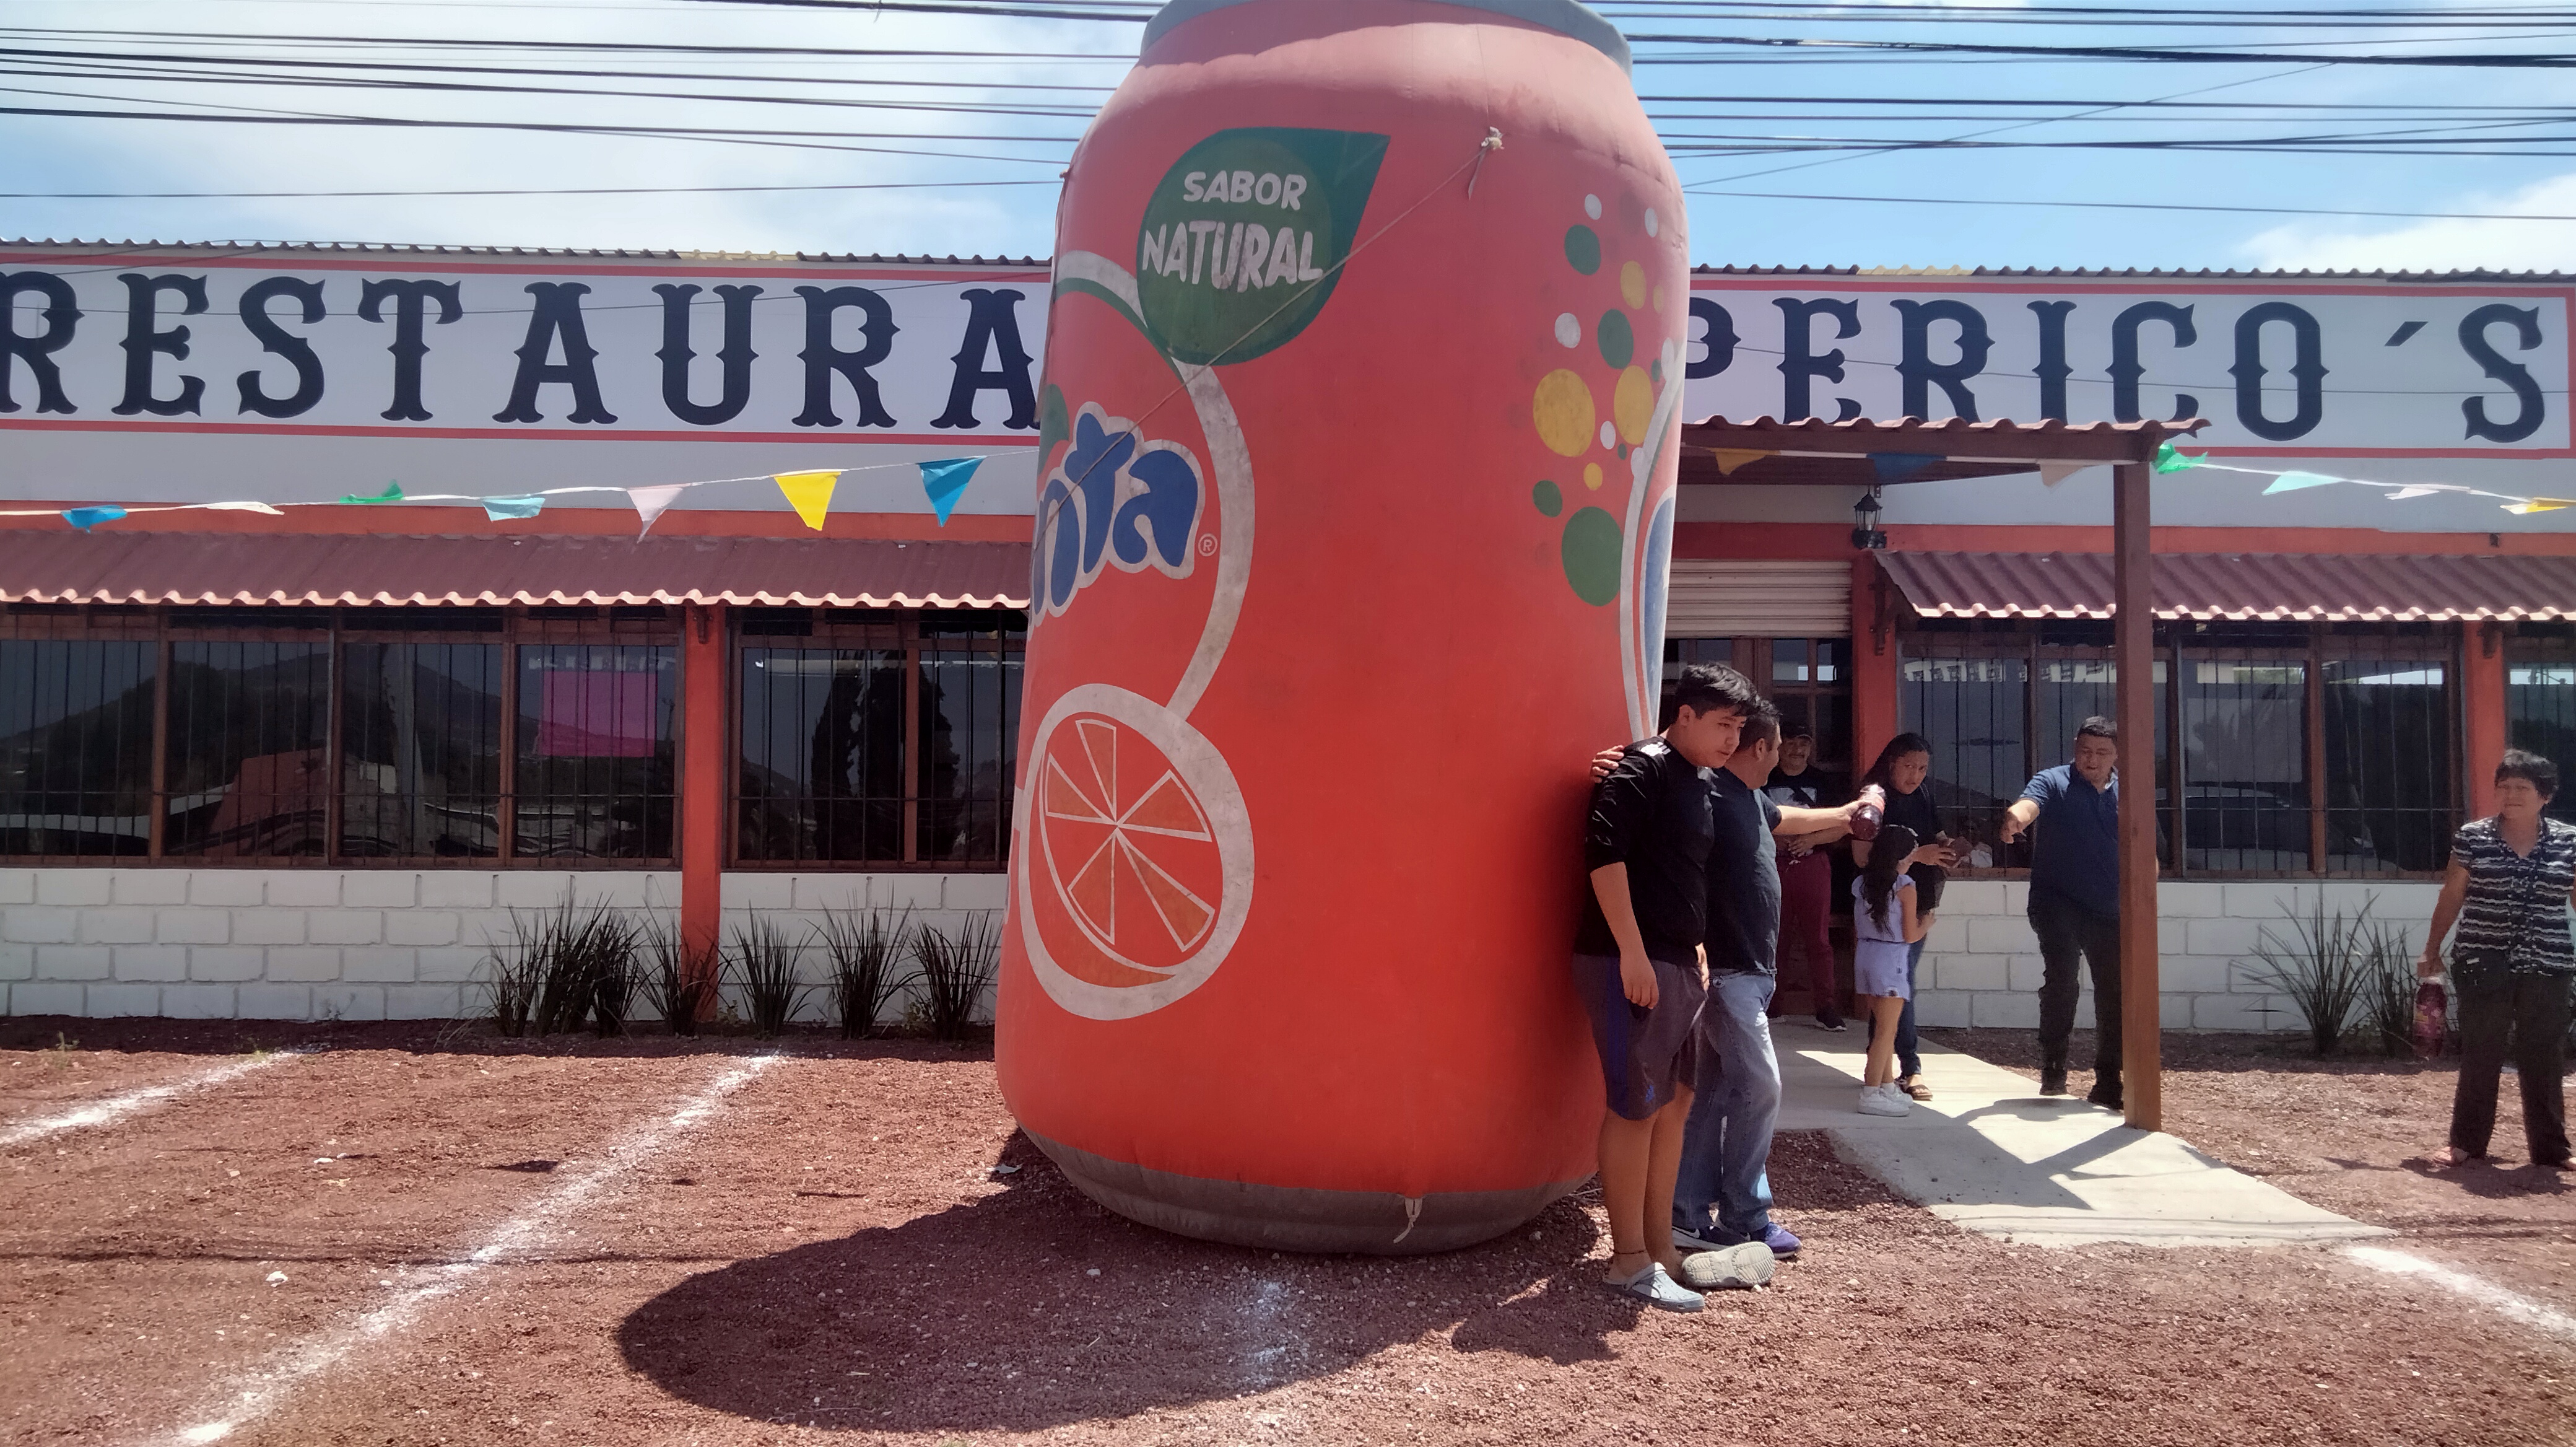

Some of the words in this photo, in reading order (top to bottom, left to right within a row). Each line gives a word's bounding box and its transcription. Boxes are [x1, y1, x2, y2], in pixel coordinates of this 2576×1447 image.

[1183, 170, 1307, 211] SABOR
[1142, 221, 1323, 292] NATURAL
[1029, 403, 1205, 626] nta
